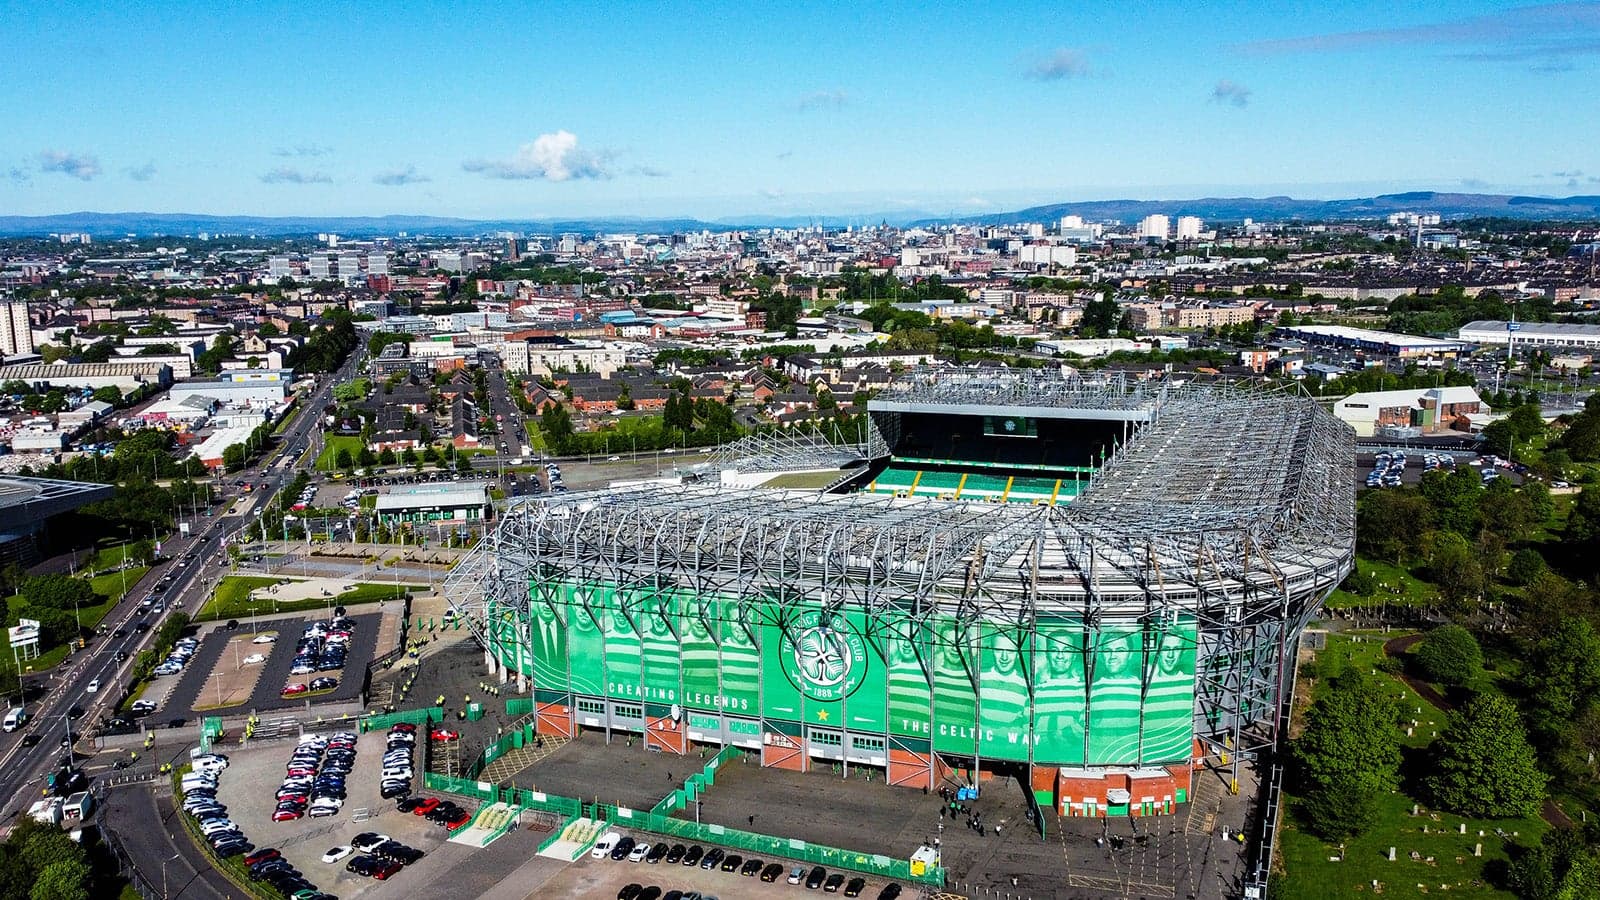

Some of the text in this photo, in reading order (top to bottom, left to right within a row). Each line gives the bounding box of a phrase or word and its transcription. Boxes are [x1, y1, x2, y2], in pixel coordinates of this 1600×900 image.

[850, 638, 864, 662] CLUB
[608, 682, 748, 710] CREATING LEGENDS
[813, 687, 833, 698] 1888
[902, 719, 1041, 746] THE CELTIC WAY
